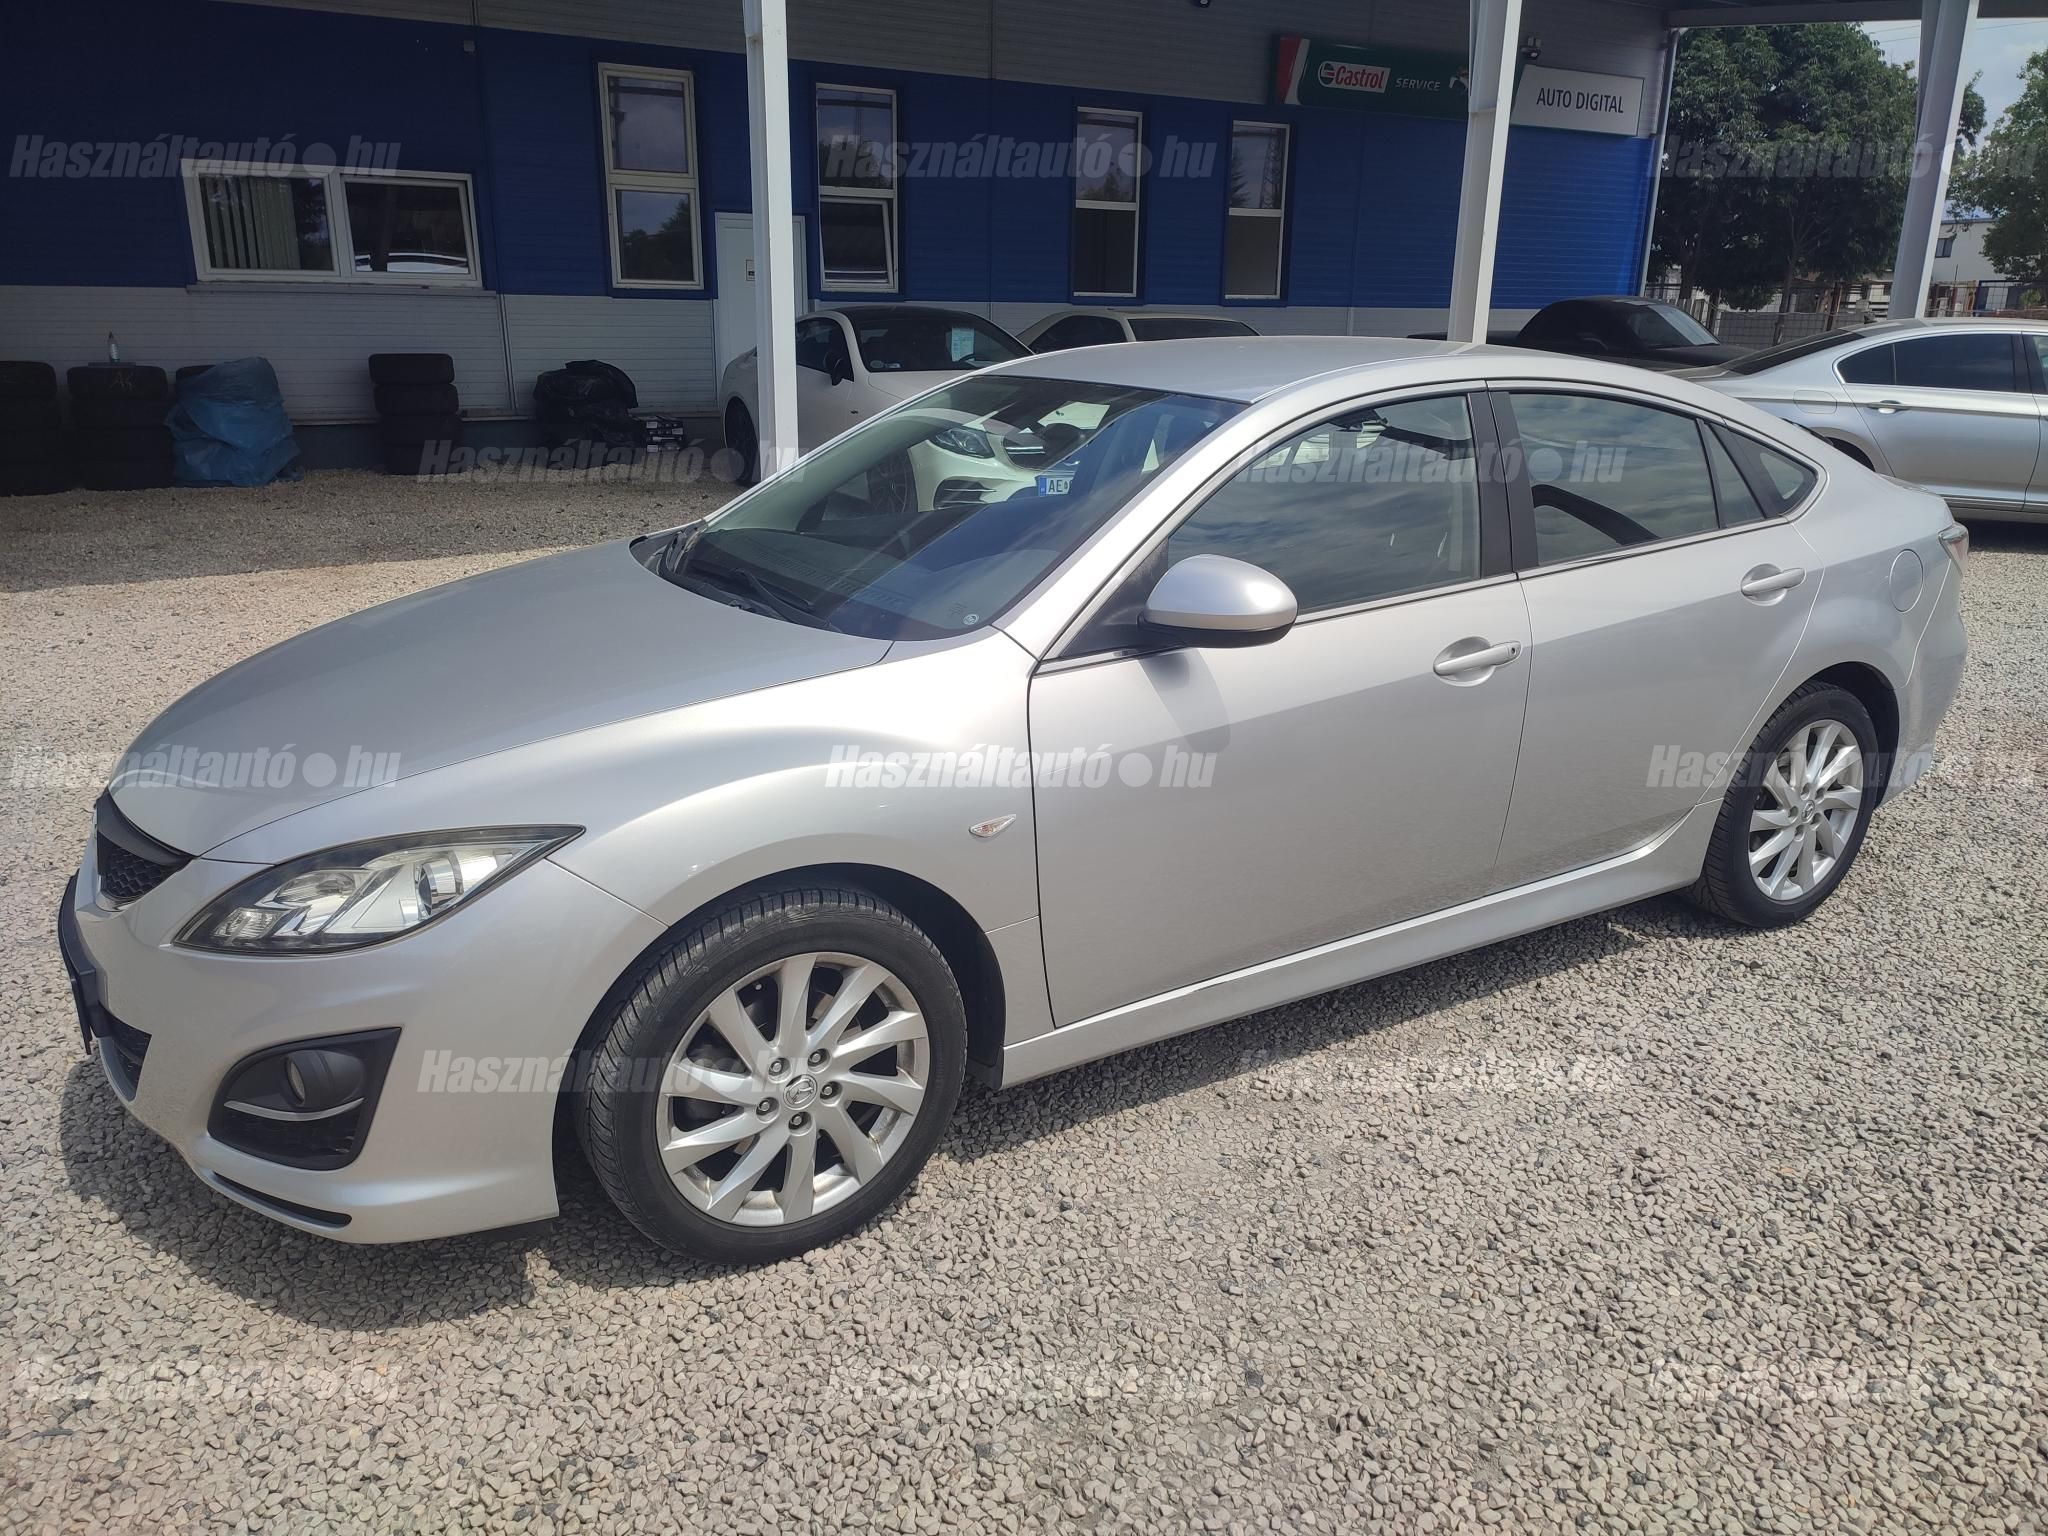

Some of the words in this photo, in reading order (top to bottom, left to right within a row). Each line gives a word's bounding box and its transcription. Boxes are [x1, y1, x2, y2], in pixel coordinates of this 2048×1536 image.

[1335, 65, 1386, 89] Castrol
[1395, 77, 1441, 92] SERVICE
[1536, 87, 1570, 108] AUTO
[1575, 92, 1624, 114] DIGITAL
